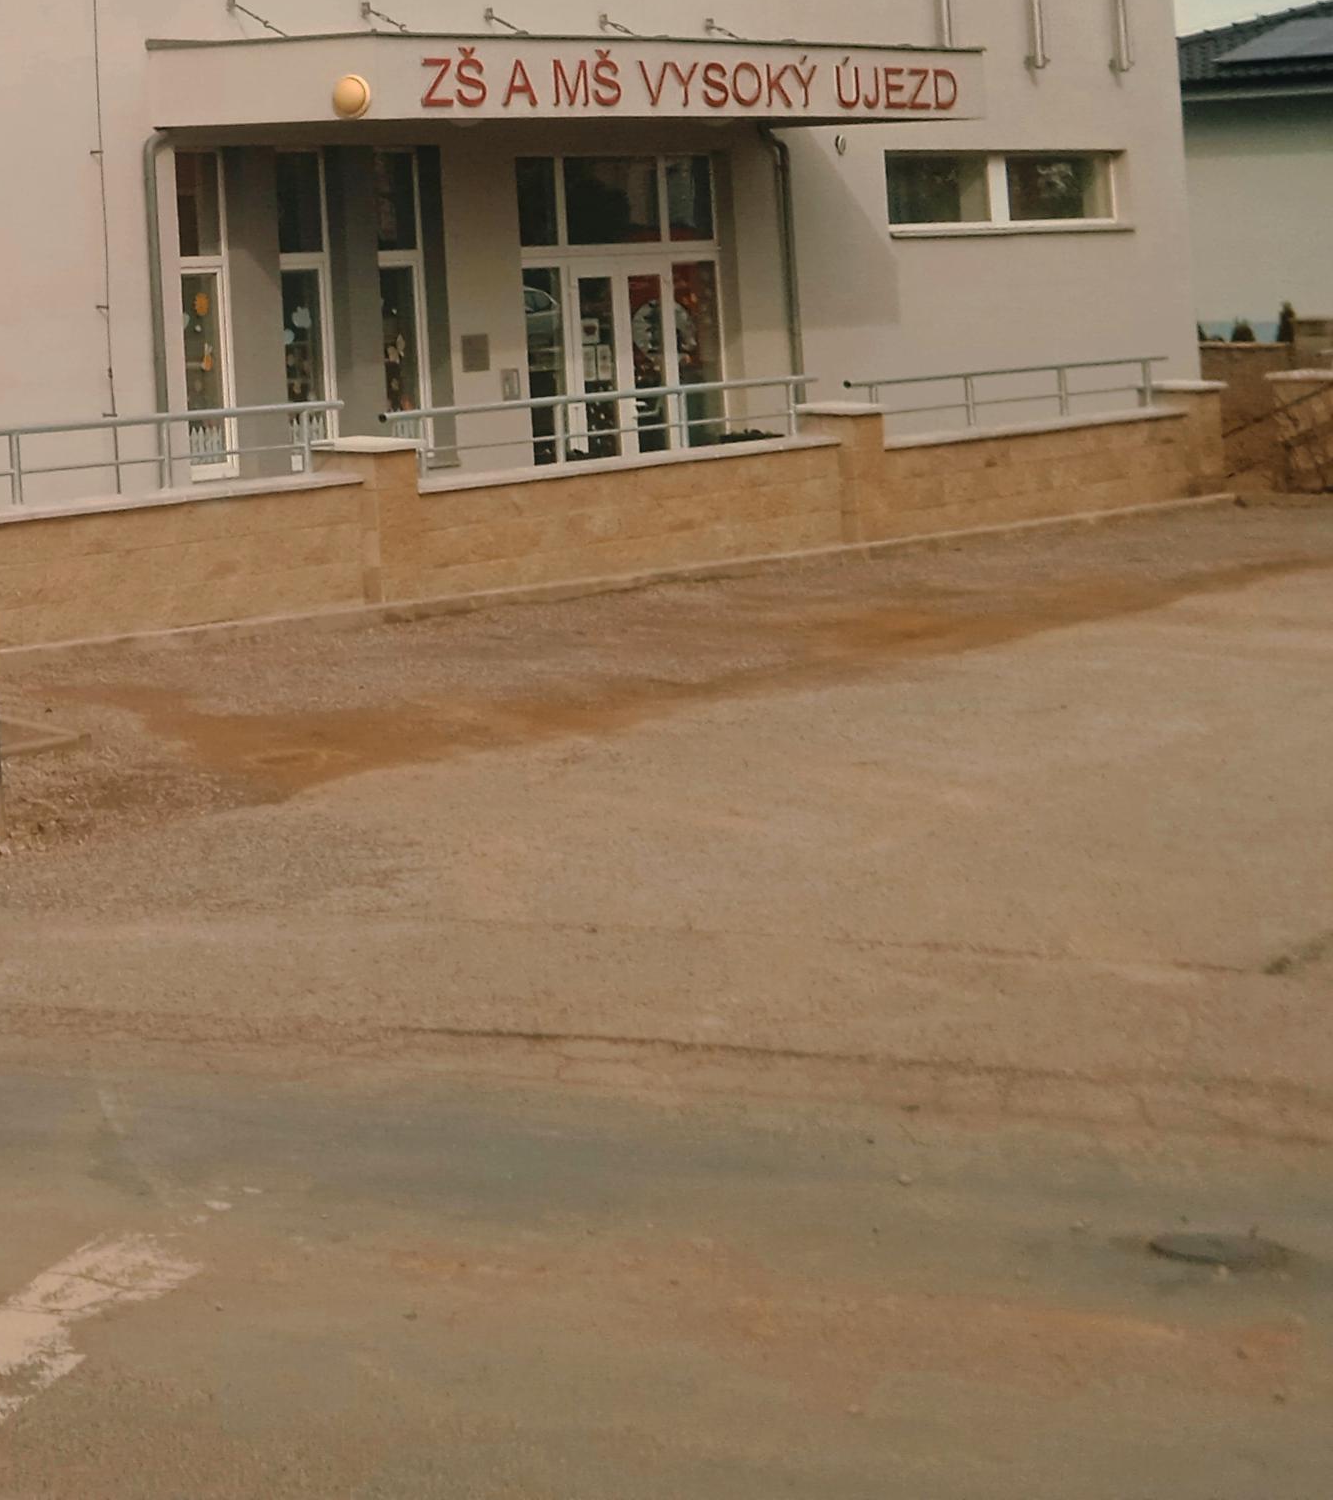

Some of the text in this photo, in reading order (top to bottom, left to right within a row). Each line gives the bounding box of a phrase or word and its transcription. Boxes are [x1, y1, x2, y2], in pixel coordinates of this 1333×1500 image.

[421, 47, 957, 110] ZŠ A MŠ VYSOKÝ ÚJEZD
